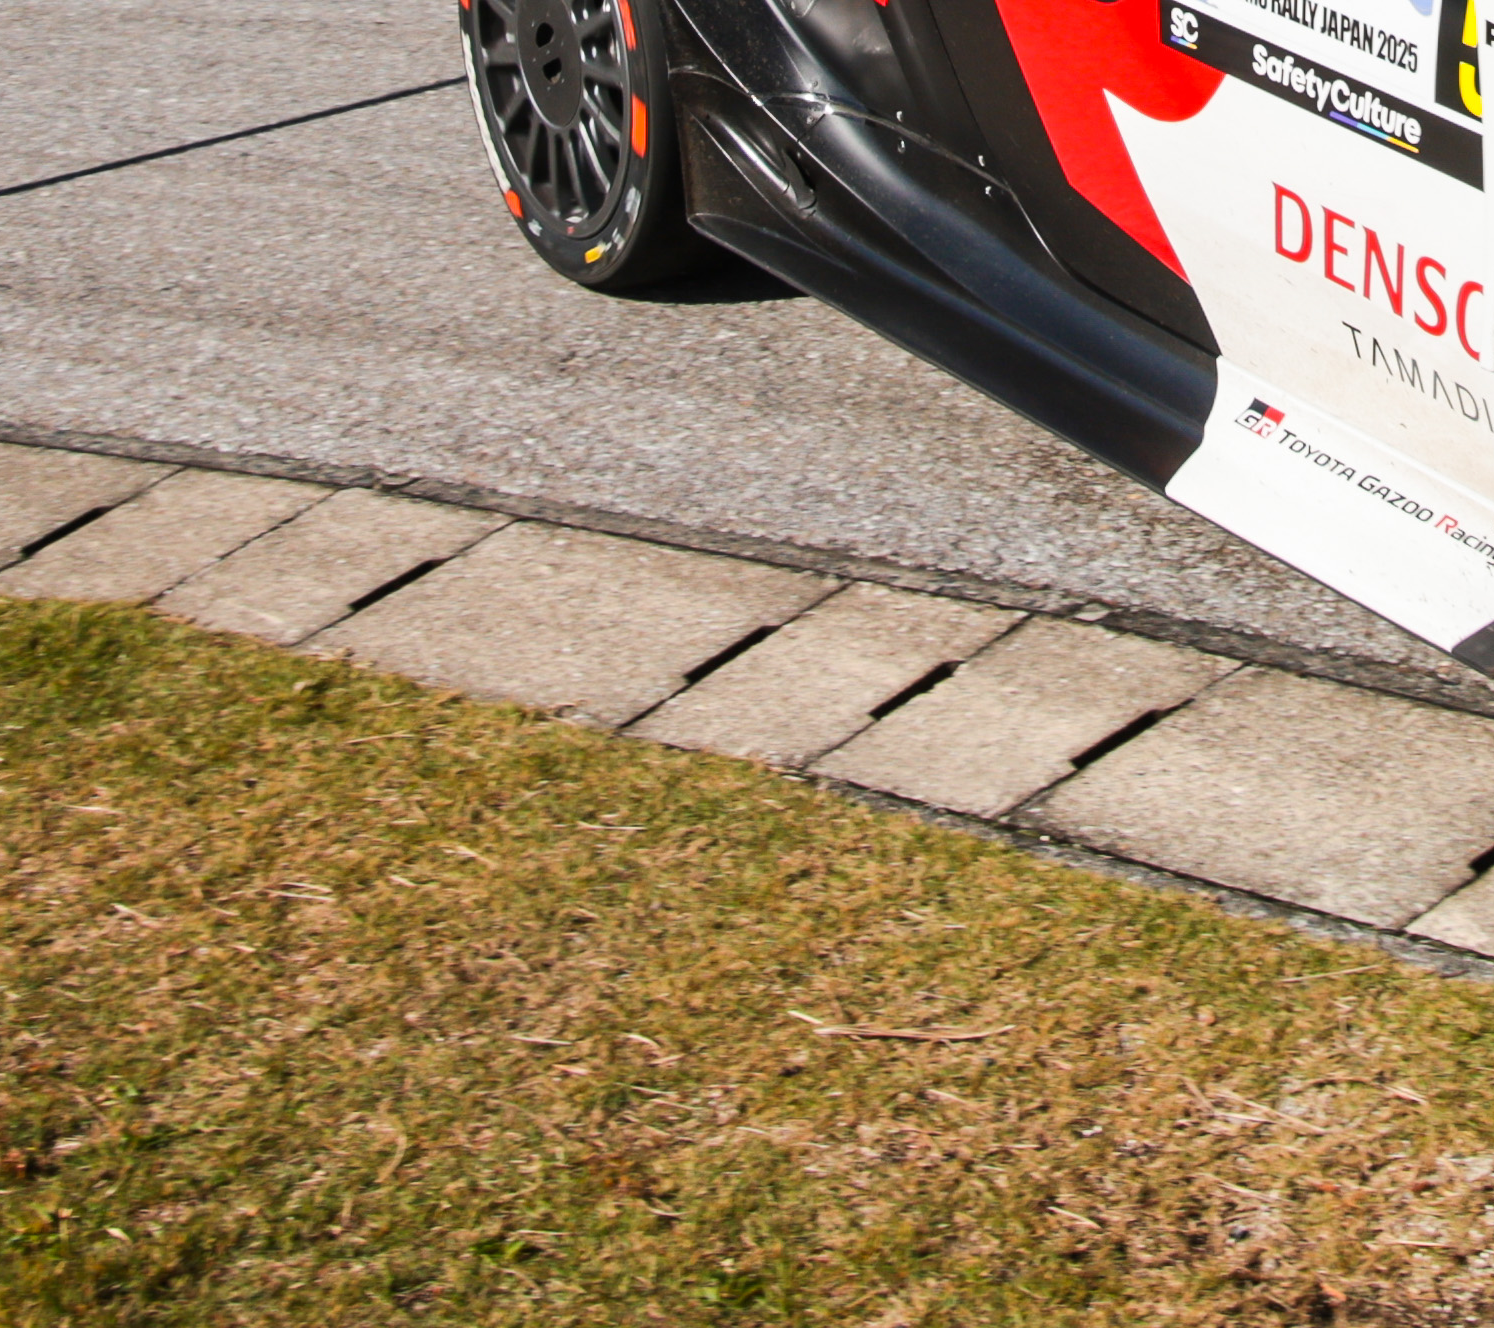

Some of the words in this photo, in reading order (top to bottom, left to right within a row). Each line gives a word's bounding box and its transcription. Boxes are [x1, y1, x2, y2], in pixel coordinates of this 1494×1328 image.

[1170, 6, 1199, 44] SC
[1320, 6, 1374, 55] JAPAN
[1377, 30, 1418, 74] 2025
[1251, 43, 1422, 145] SafetyCulture
[1235, 403, 1282, 439] GR
[1278, 428, 1357, 482] TOYOTA
[1356, 474, 1435, 523] GAZOO
